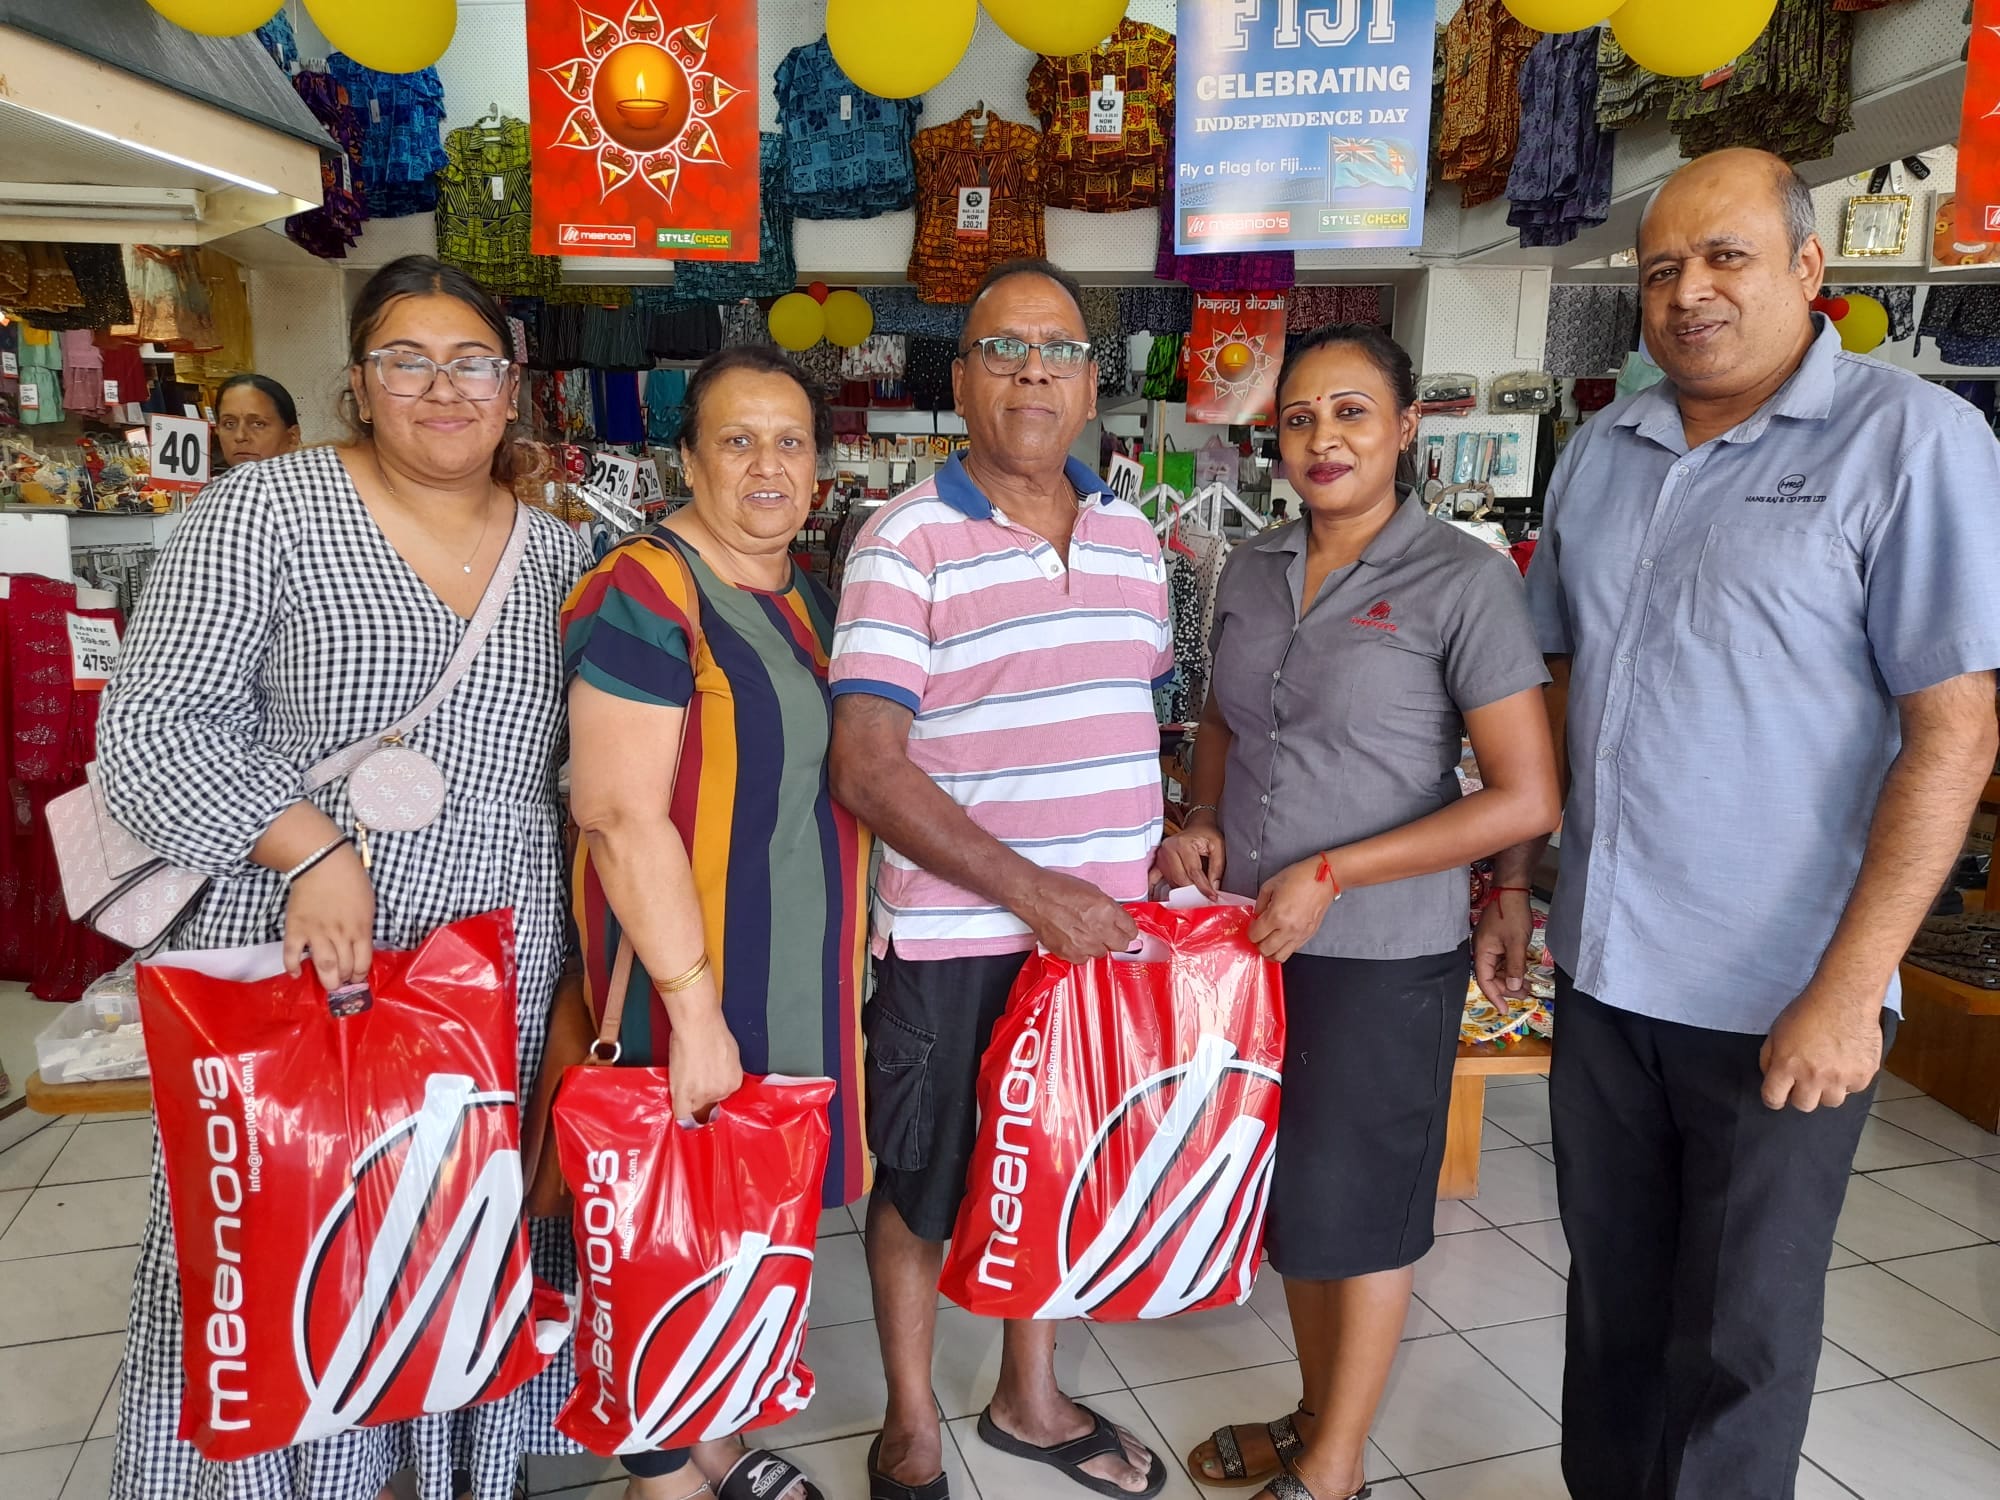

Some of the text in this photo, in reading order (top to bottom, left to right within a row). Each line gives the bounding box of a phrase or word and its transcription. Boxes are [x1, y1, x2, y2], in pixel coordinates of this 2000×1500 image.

[1215, 0, 1395, 51] FIJI
[1196, 65, 1411, 101] CELEBRATING
[1195, 108, 1410, 133] INDEPENDENCE DAY
[1179, 163, 1199, 179] Fly
[1204, 165, 1214, 175] a
[1219, 160, 1251, 176] Flag
[1255, 160, 1276, 173] for
[1322, 212, 1407, 226] STYLE CHECK
[658, 233, 729, 244] STYLE CHECK
[1197, 293, 1285, 315] happy diwali
[159, 431, 200, 476] 40
[594, 460, 629, 497] 25%
[237, 1052, 263, 1192] info@meenoos.com.fj
[192, 1056, 251, 1432] meenoo's
[582, 1149, 620, 1424] meenoo's
